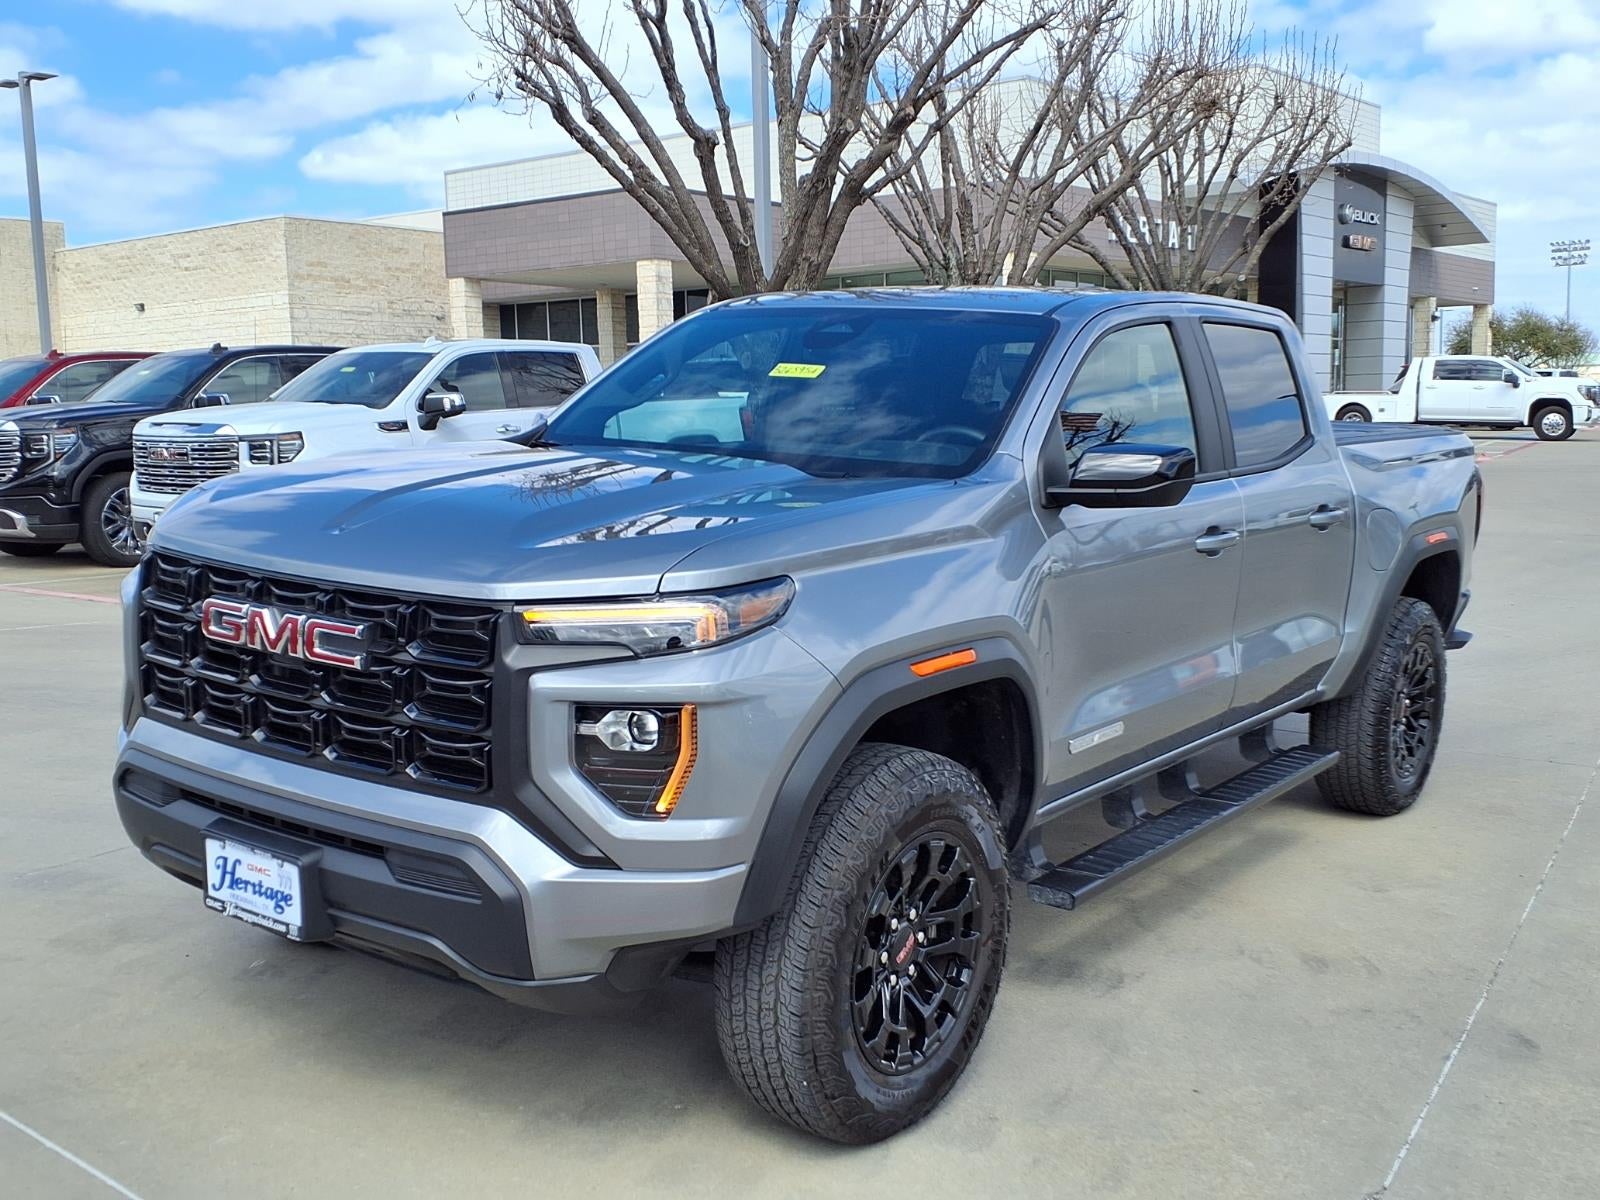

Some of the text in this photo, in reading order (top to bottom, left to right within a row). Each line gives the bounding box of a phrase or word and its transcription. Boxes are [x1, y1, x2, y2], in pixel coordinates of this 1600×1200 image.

[1354, 209, 1380, 225] BUICK
[202, 597, 366, 671] GMC
[211, 855, 294, 915] Heritage
[246, 863, 272, 878] GMC
